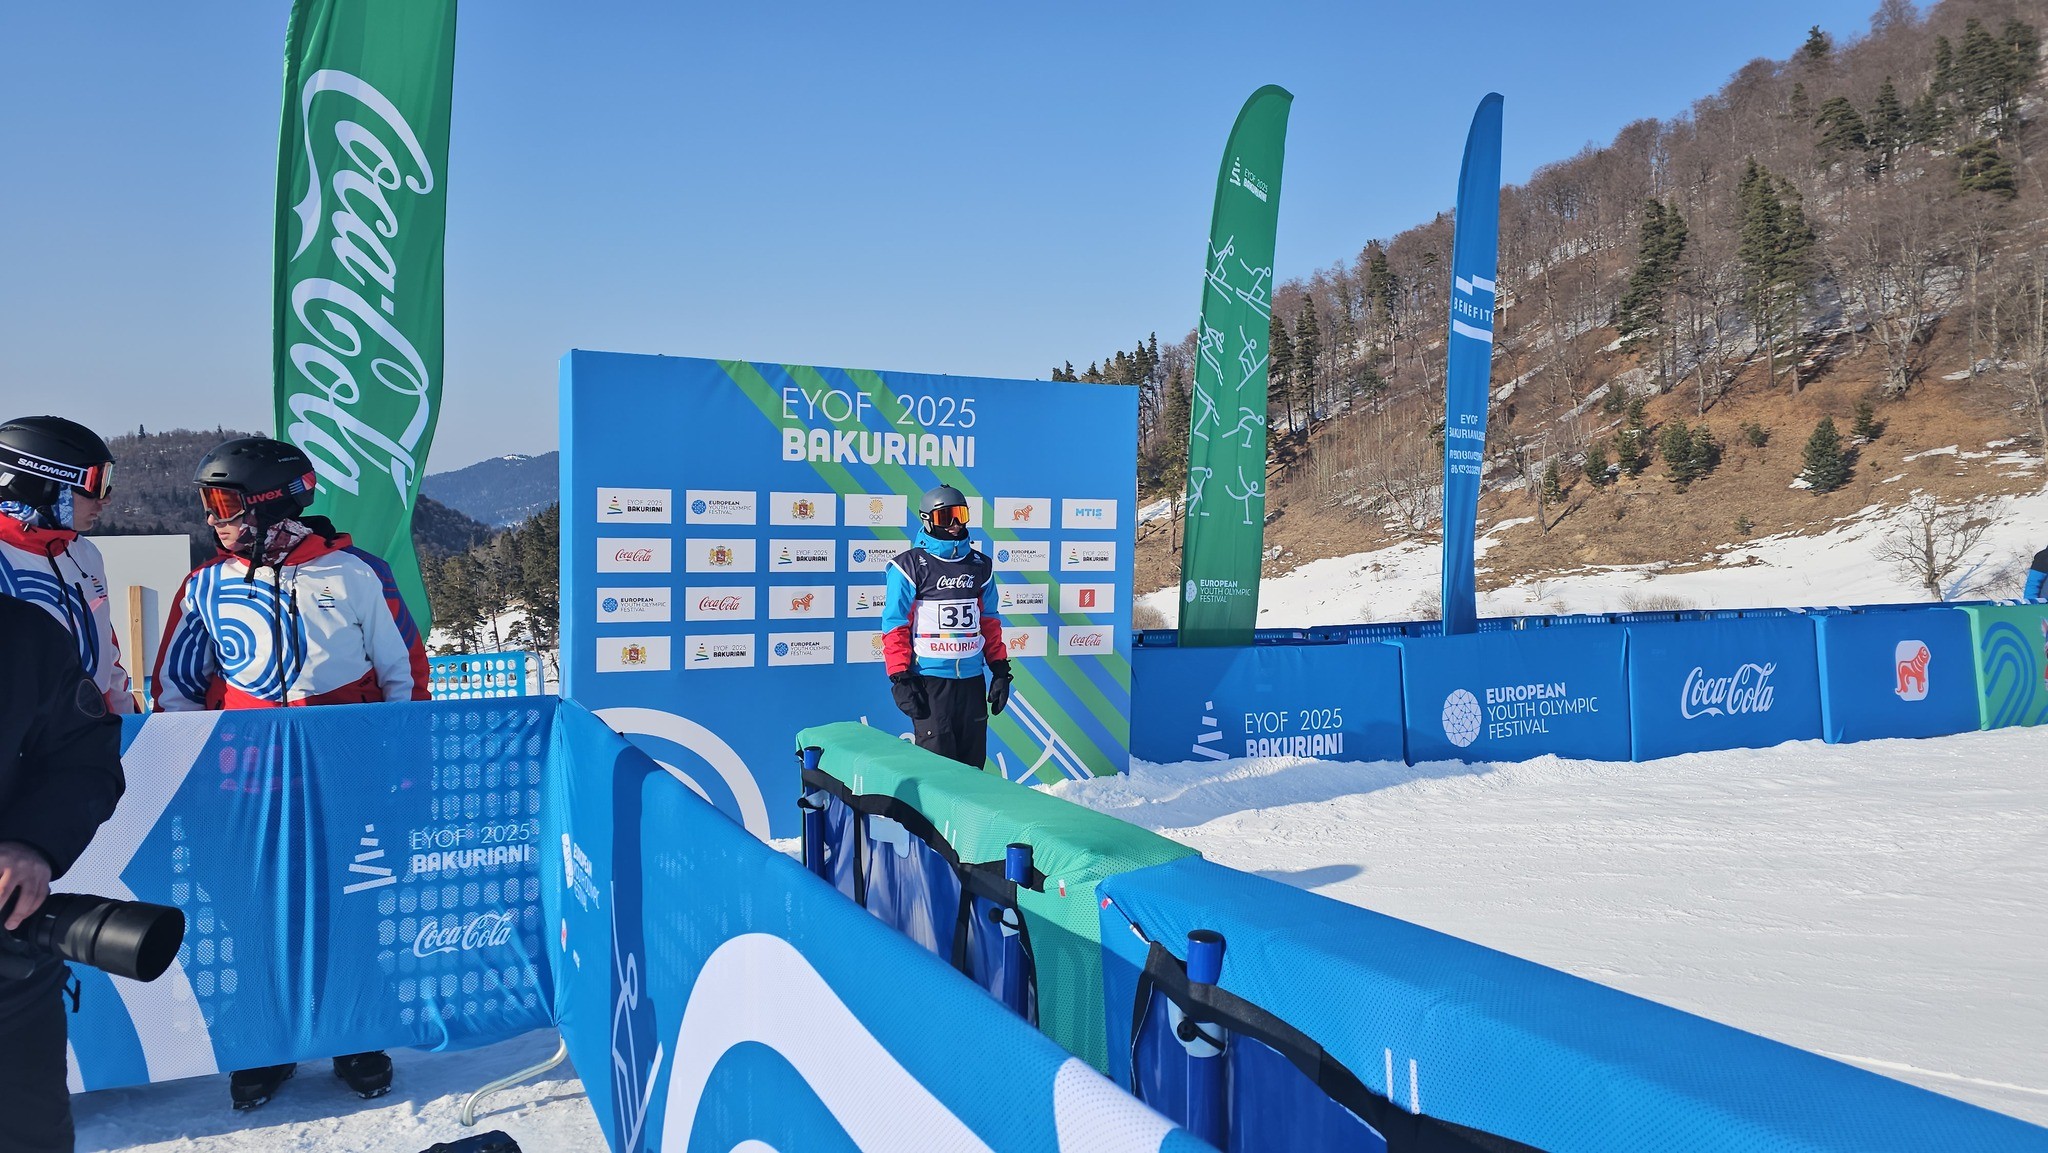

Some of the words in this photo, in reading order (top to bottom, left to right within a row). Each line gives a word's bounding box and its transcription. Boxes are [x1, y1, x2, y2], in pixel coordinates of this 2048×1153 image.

[288, 69, 434, 510] Coca-Cola
[782, 387, 872, 422] EYOF
[896, 394, 976, 428] 2025
[1460, 414, 1478, 425] EYOF
[782, 427, 975, 468] BAKURIANI
[17, 457, 78, 479] SALOMON
[246, 488, 283, 505] uvex
[1075, 508, 1102, 516] MTIS
[1200, 579, 1238, 588] EUROPEAN
[1200, 587, 1223, 595] YOUTH
[1224, 588, 1251, 596] OLYMPIC
[1200, 595, 1227, 603] FESTIVAL
[942, 605, 974, 628] 35
[1486, 682, 1566, 704] EUROPEAN
[1681, 662, 1777, 719] Coca-Cola
[1244, 711, 1288, 733] EYOF
[1300, 708, 1343, 730] 2025
[1487, 701, 1536, 721] YOUTH
[1539, 696, 1599, 716] OLYMPIC
[1489, 718, 1549, 739] FESTIVAL
[1245, 732, 1343, 758] BAKURIANI
[412, 828, 467, 850] EYOF
[480, 823, 530, 844] 2025
[412, 843, 530, 874] BAKURIANI
[413, 912, 511, 958] Coca-Cola
